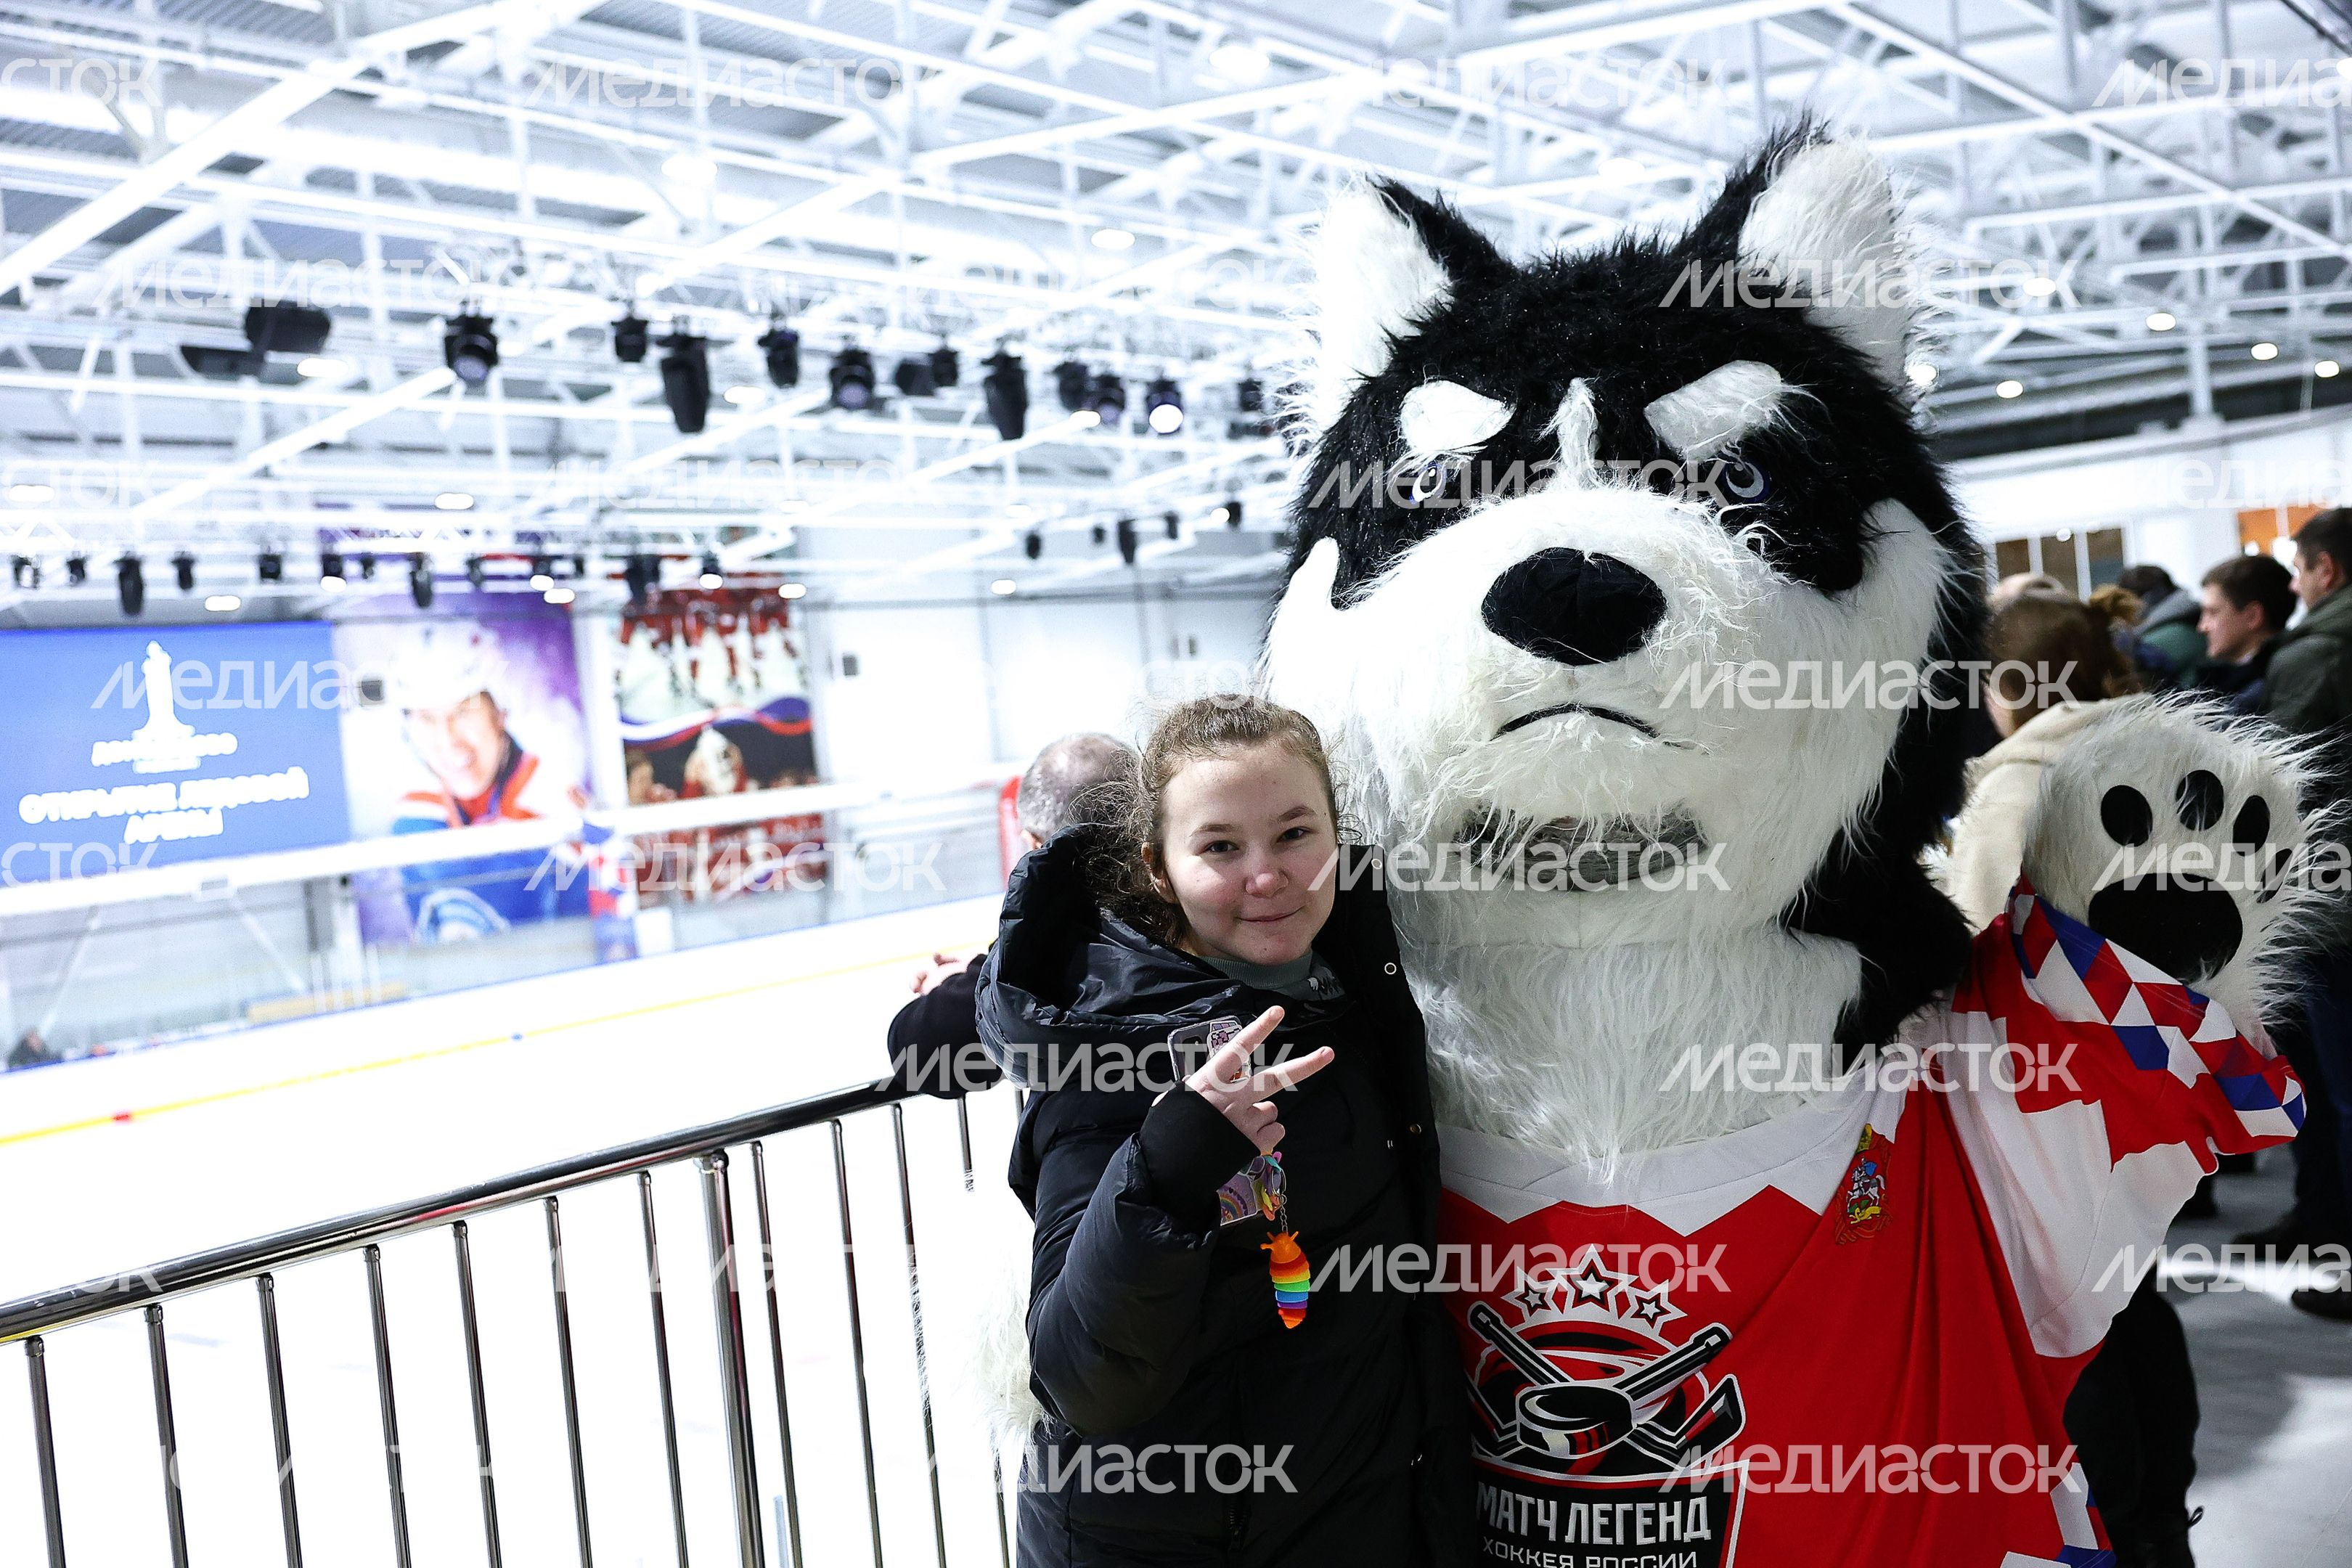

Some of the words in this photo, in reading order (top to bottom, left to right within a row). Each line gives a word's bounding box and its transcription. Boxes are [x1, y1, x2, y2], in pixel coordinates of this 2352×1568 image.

[1476, 1481, 1557, 1542] МАТЧ
[1564, 1495, 1712, 1545] ЛЕГЕНД
[1482, 1536, 1574, 1568] ХОККЕЯ
[1585, 1551, 1697, 1568] РОССИИ
